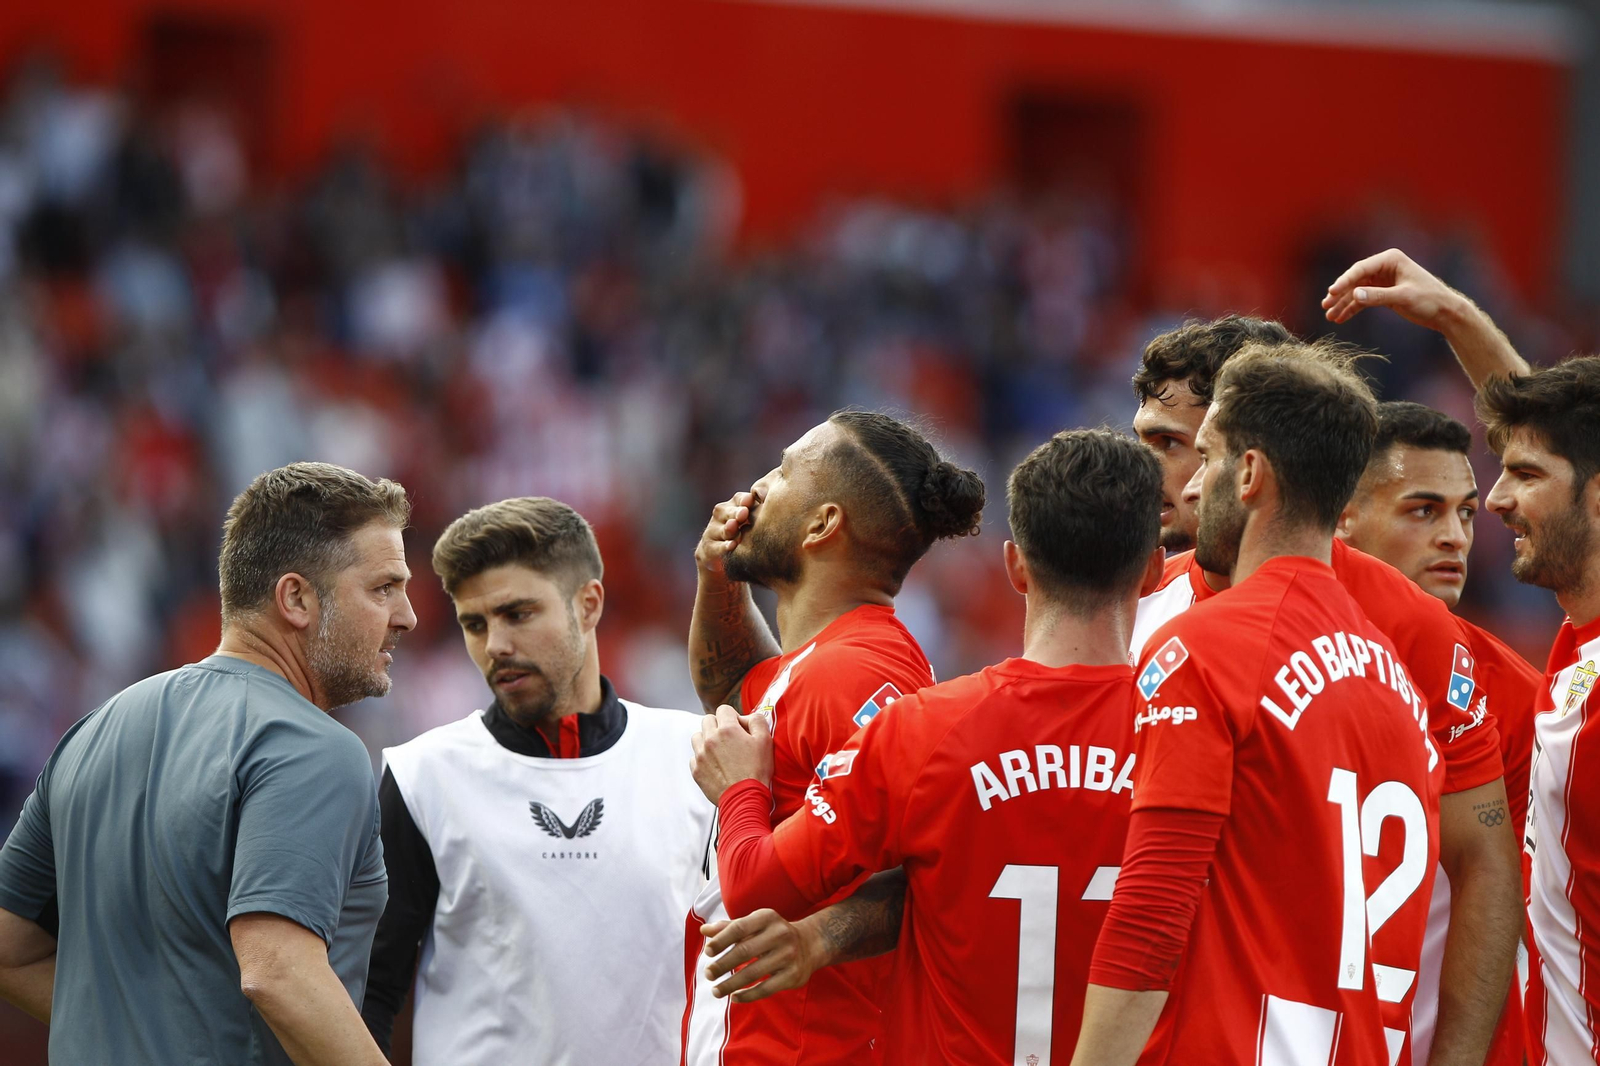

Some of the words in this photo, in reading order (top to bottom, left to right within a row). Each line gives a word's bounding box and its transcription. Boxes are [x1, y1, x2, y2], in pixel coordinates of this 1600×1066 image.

[1260, 650, 1325, 731] LEO
[541, 851, 598, 860] CASTORE
[1327, 767, 1429, 1004] 12
[988, 864, 1122, 1066] 1
